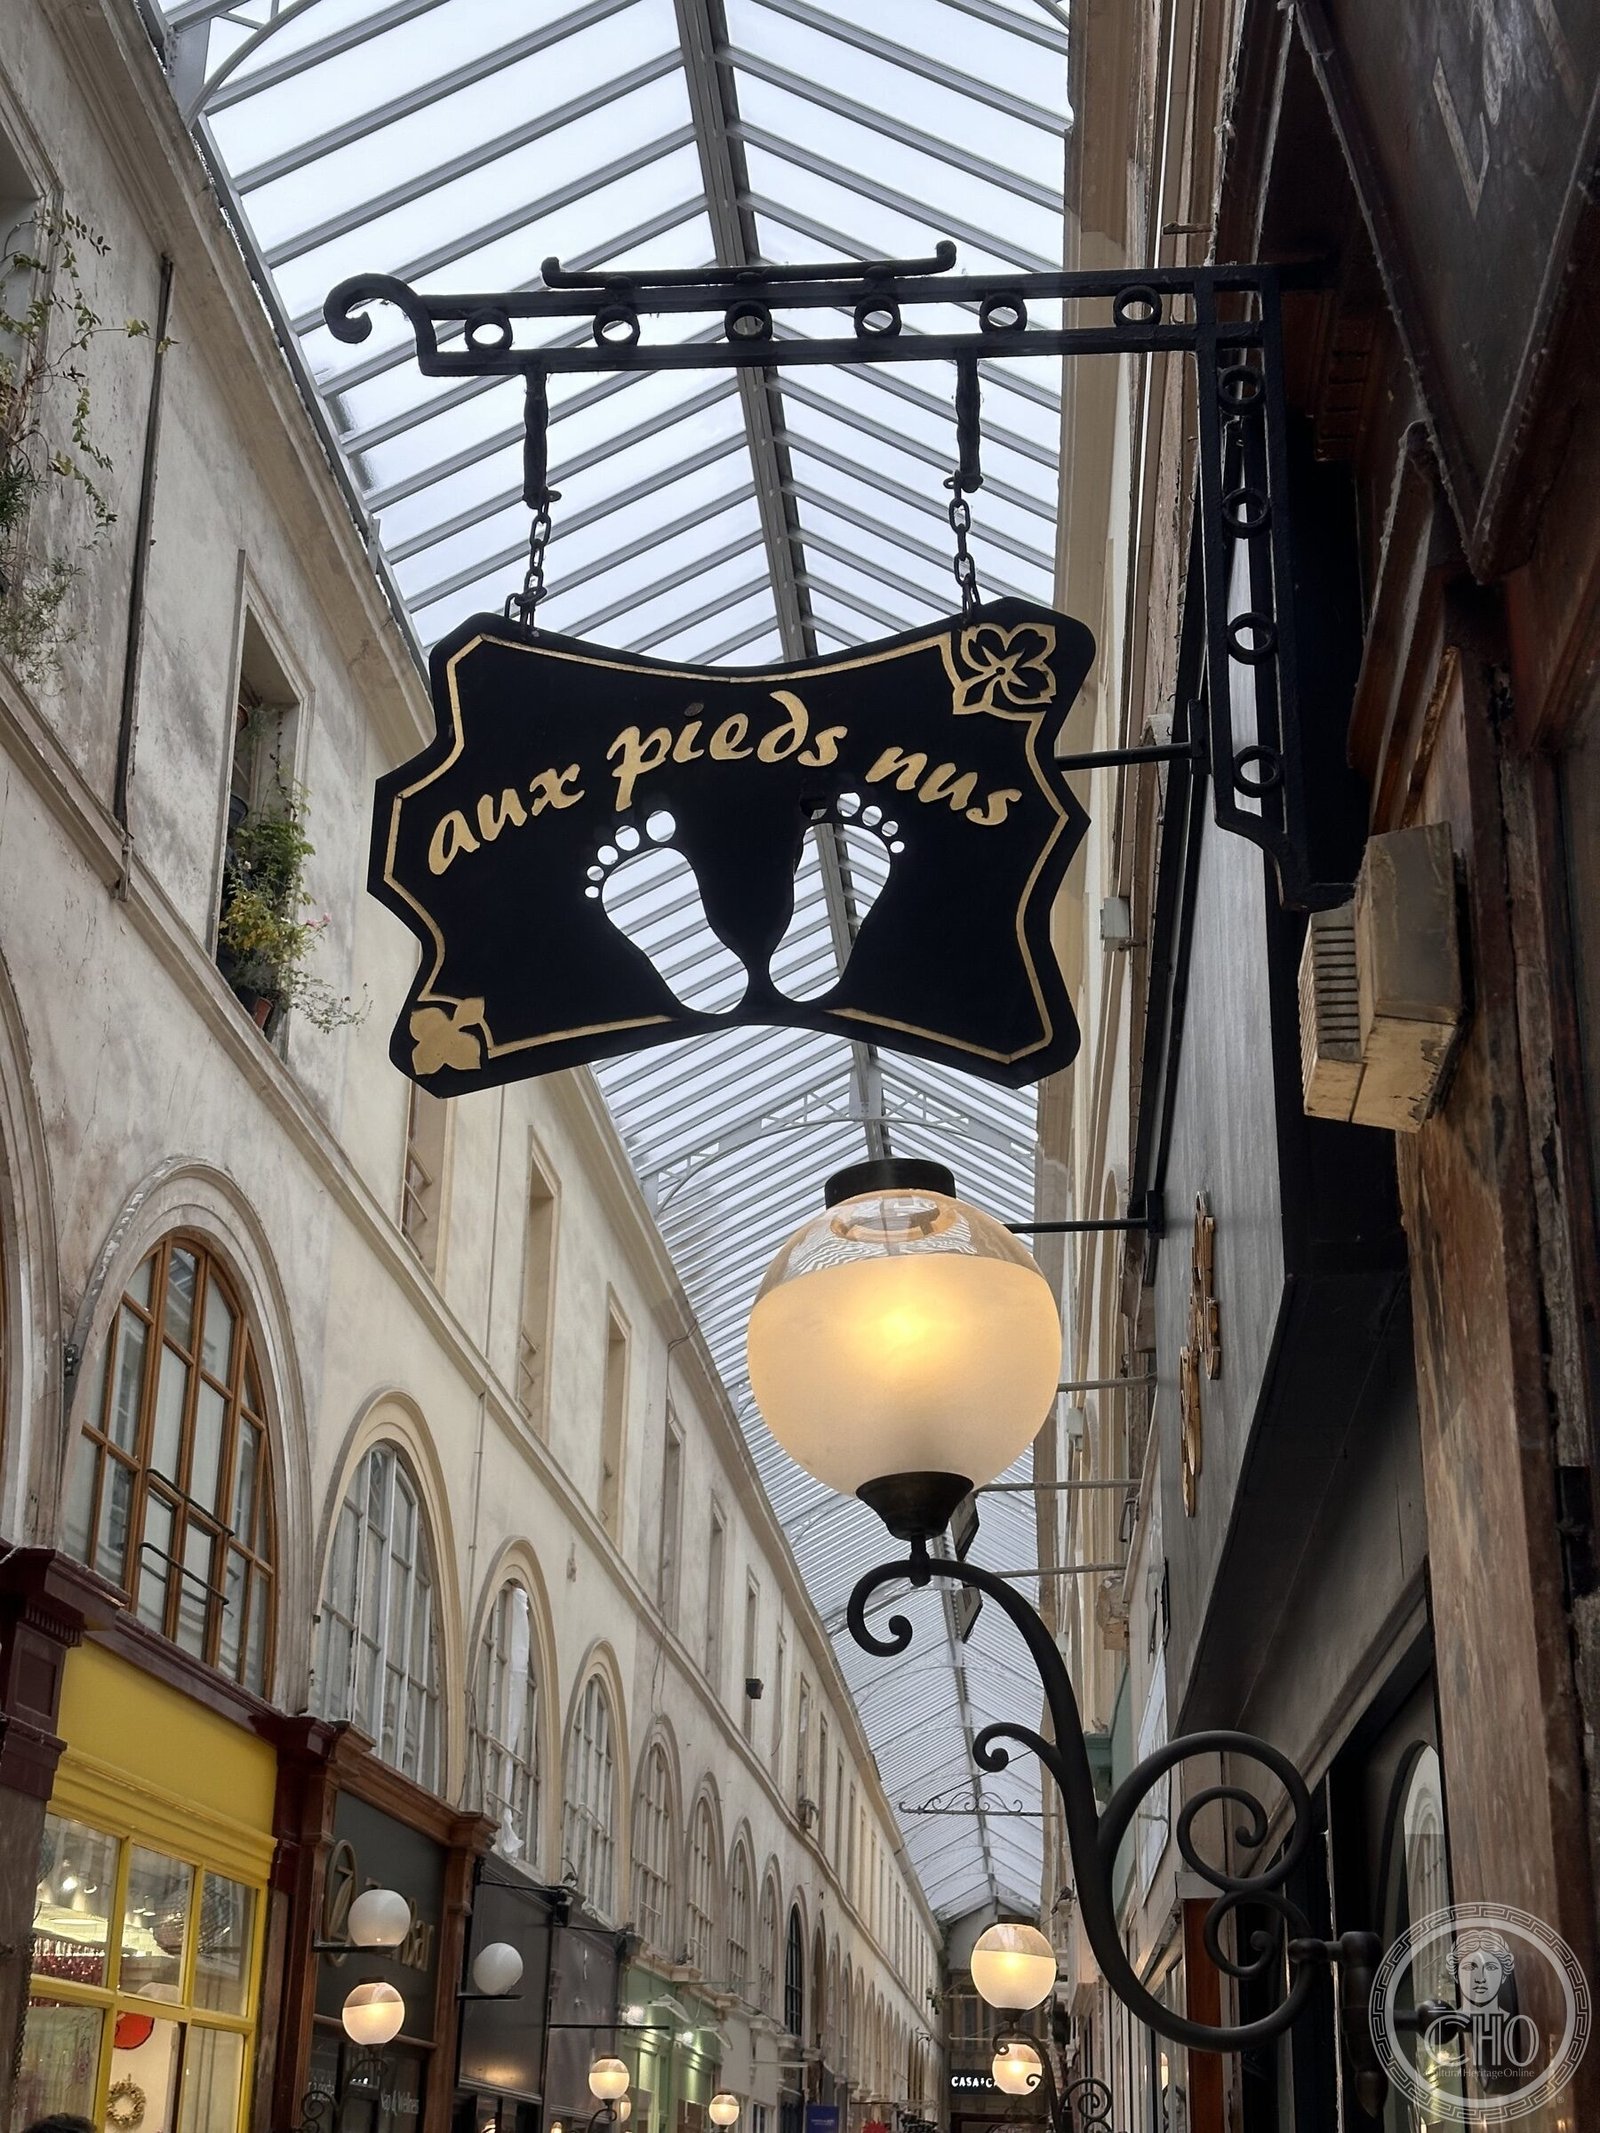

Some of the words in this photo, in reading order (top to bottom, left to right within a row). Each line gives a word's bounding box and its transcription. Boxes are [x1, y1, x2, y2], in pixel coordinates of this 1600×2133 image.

[428, 763, 585, 876] aux
[606, 690, 848, 812] pieds
[865, 746, 1023, 826] nus
